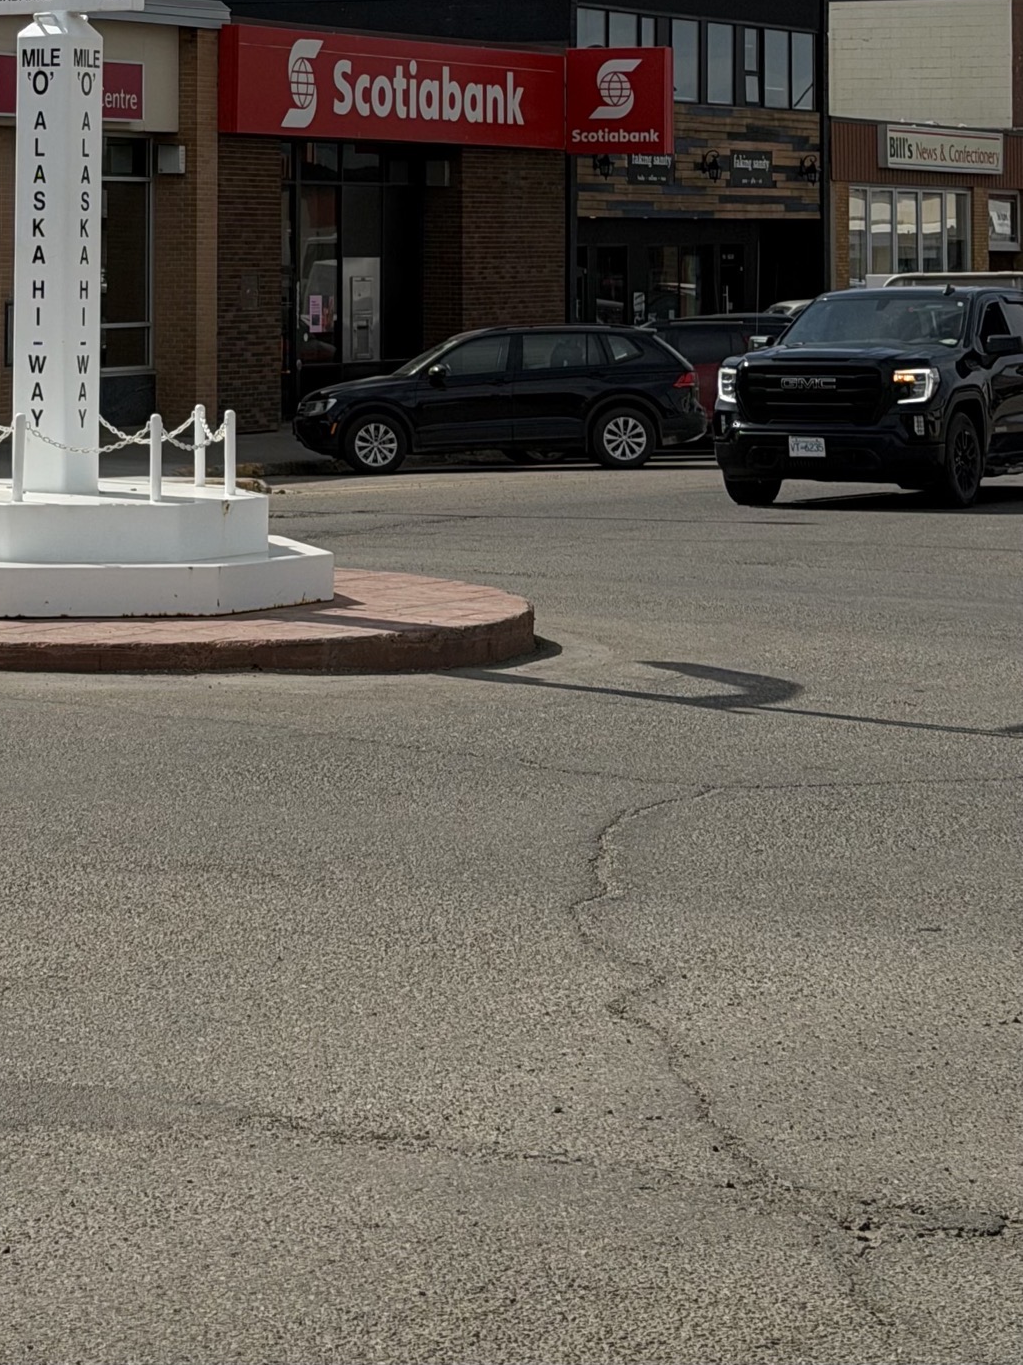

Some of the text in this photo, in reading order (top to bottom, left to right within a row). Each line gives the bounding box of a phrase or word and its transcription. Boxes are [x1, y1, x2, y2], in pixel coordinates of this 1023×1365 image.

[22, 48, 61, 68] MILE
[73, 48, 100, 69] MILE
[102, 87, 138, 110] entre
[333, 59, 525, 125] Scotiabank
[571, 128, 659, 143] Scotiabank
[889, 136, 1000, 168] Bill's News & Confectionery
[32, 110, 47, 264] ALASKA
[80, 111, 91, 265] ALASKA
[781, 377, 836, 389] GMC
